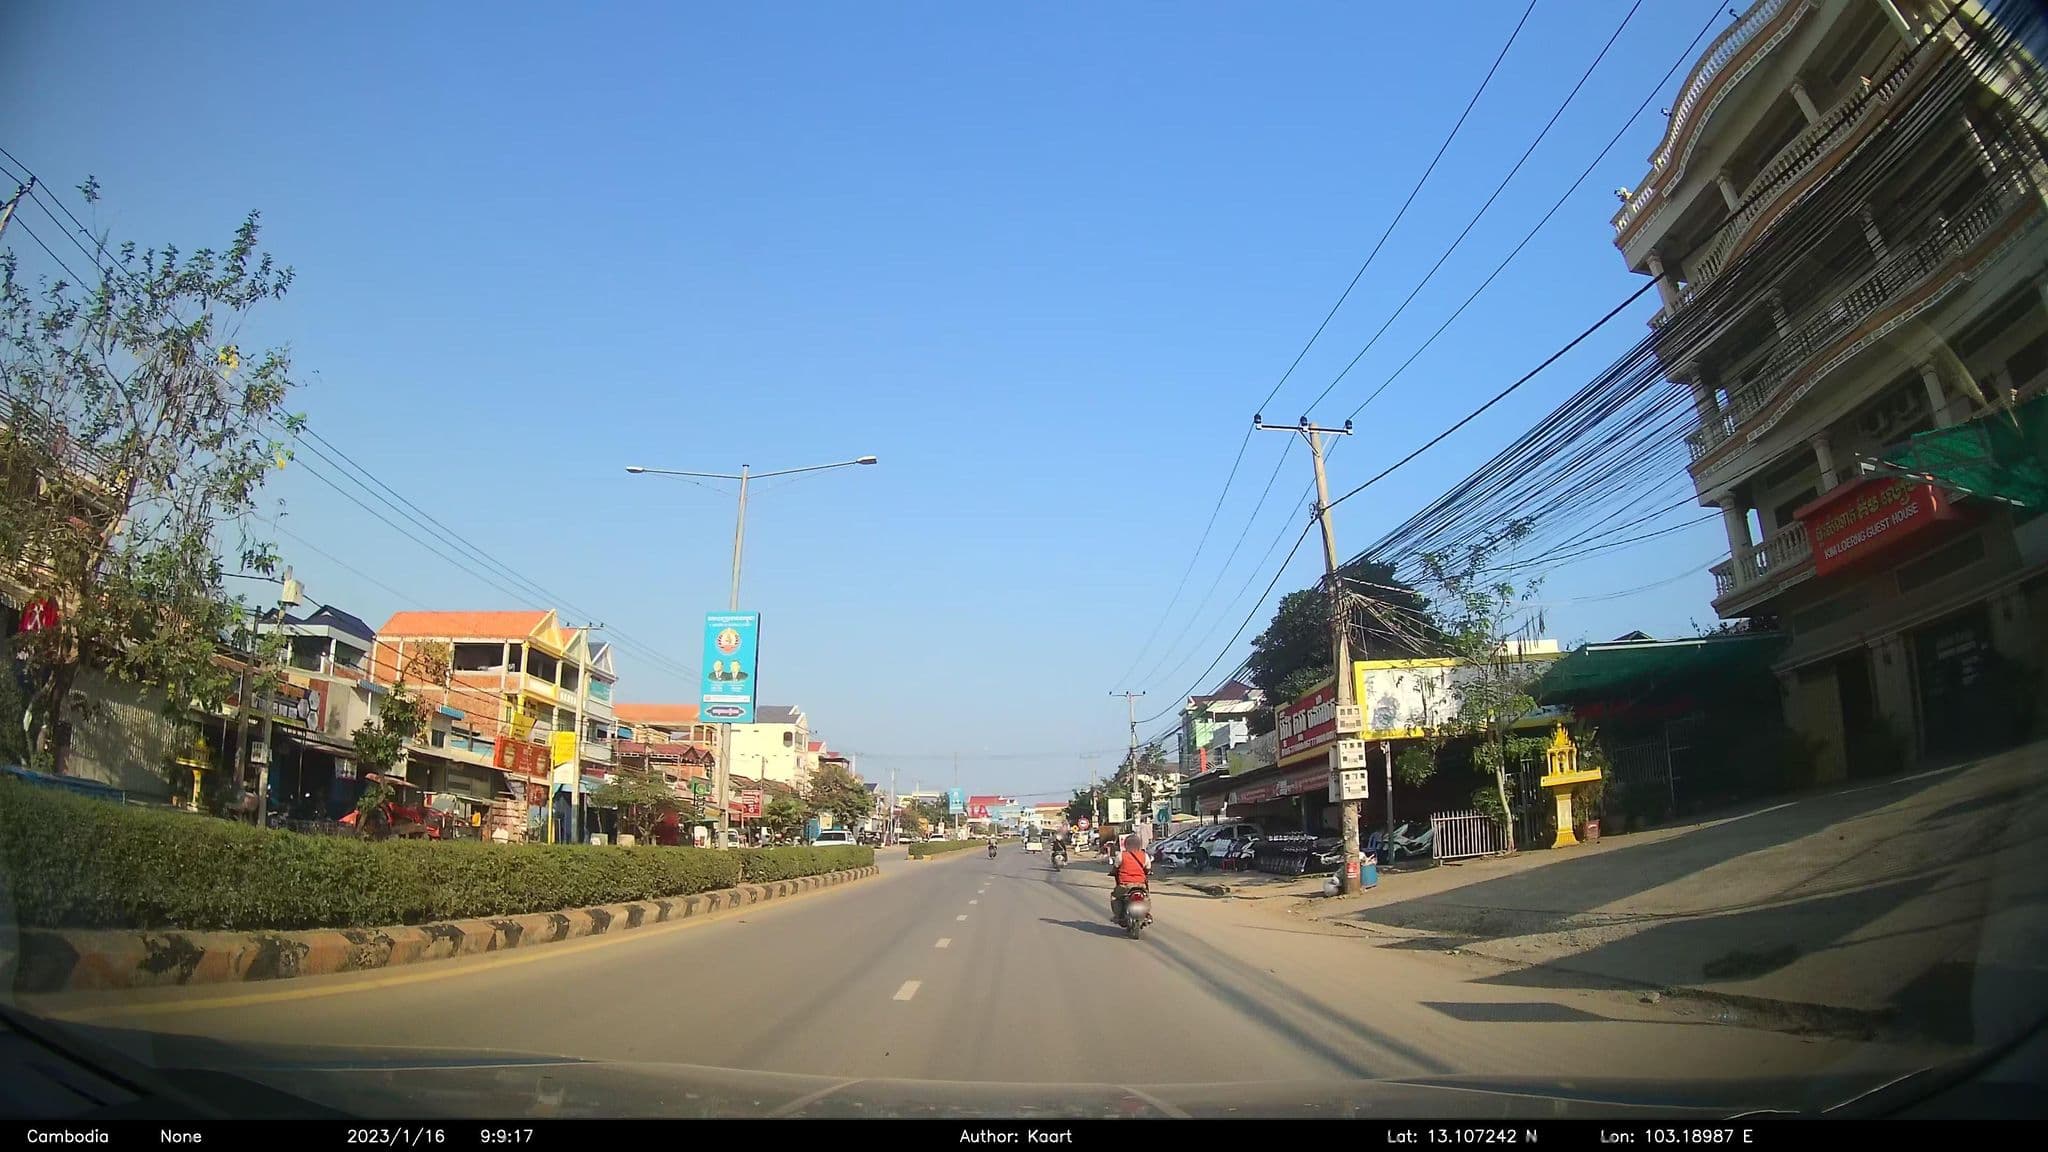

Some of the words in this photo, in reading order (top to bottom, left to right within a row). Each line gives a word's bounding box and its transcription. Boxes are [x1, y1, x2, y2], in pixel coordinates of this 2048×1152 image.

[1824, 546, 1838, 559] KIM
[1866, 518, 1890, 538] GUEST
[1891, 504, 1919, 524] HOUSE
